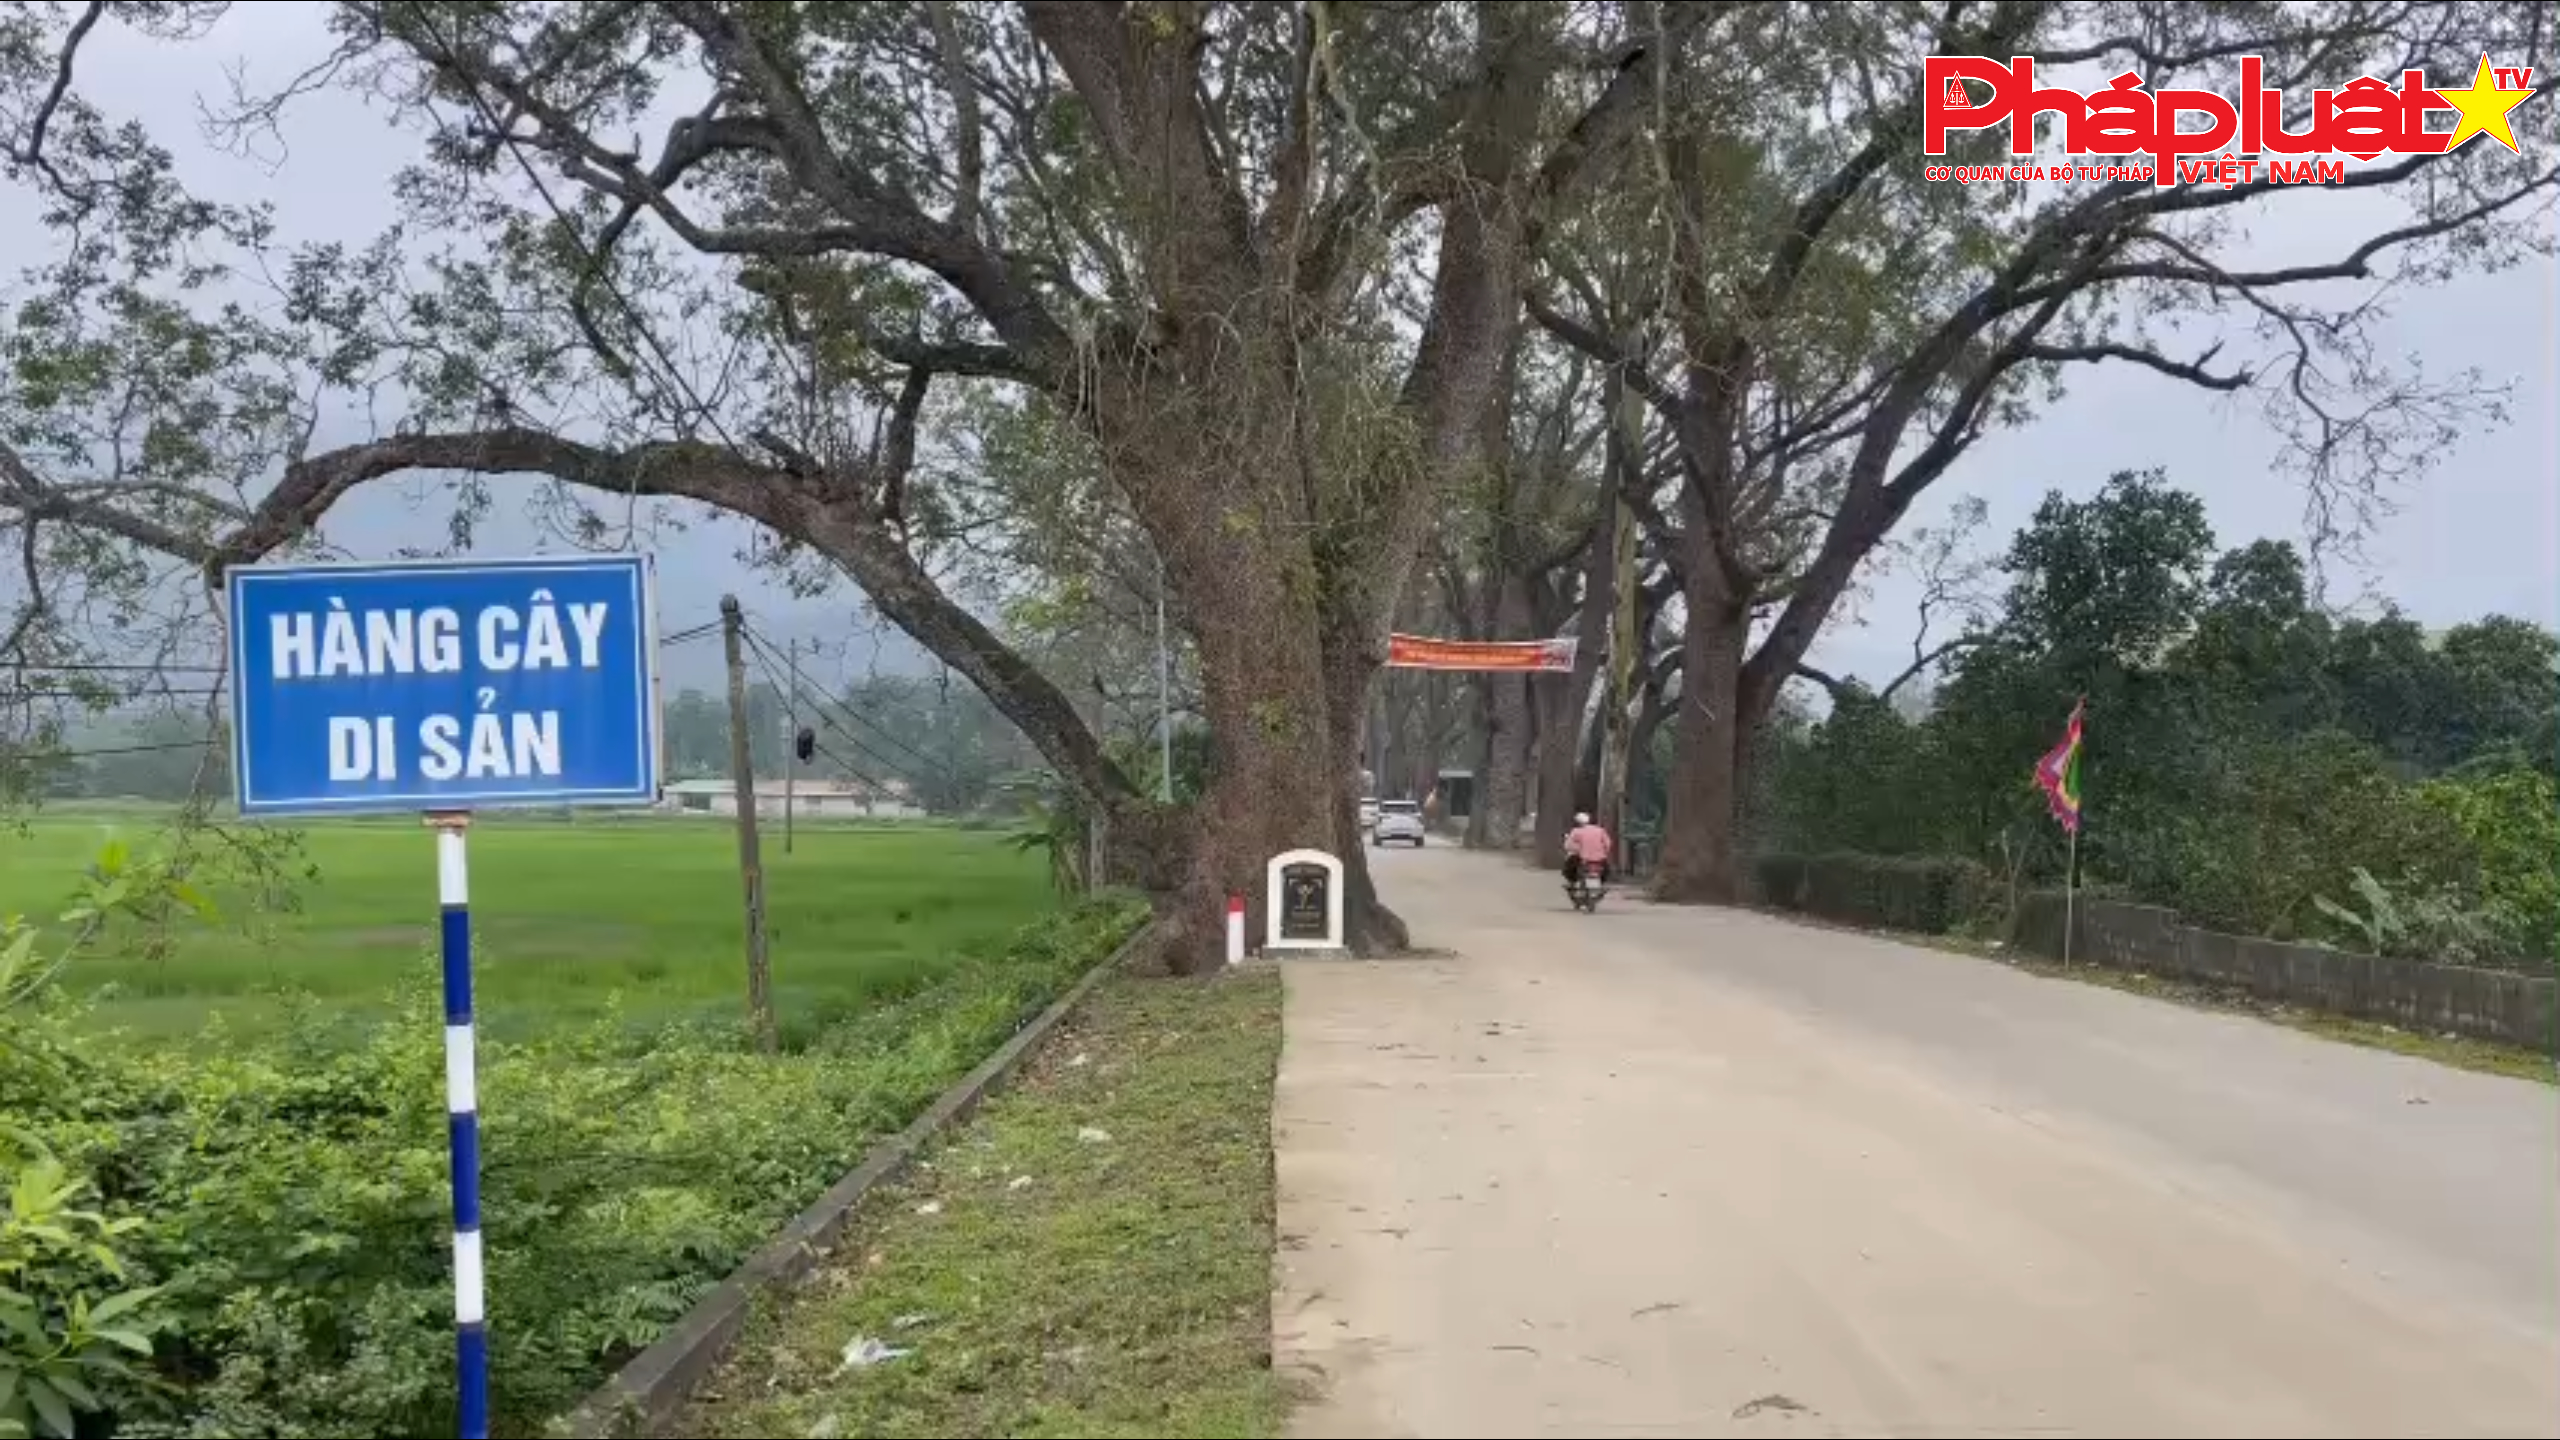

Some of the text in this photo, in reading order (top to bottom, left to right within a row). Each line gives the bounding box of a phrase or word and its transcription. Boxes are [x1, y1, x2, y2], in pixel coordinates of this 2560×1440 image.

[271, 588, 608, 679] HÀNG CÂY
[328, 686, 562, 782] DI SẢN
